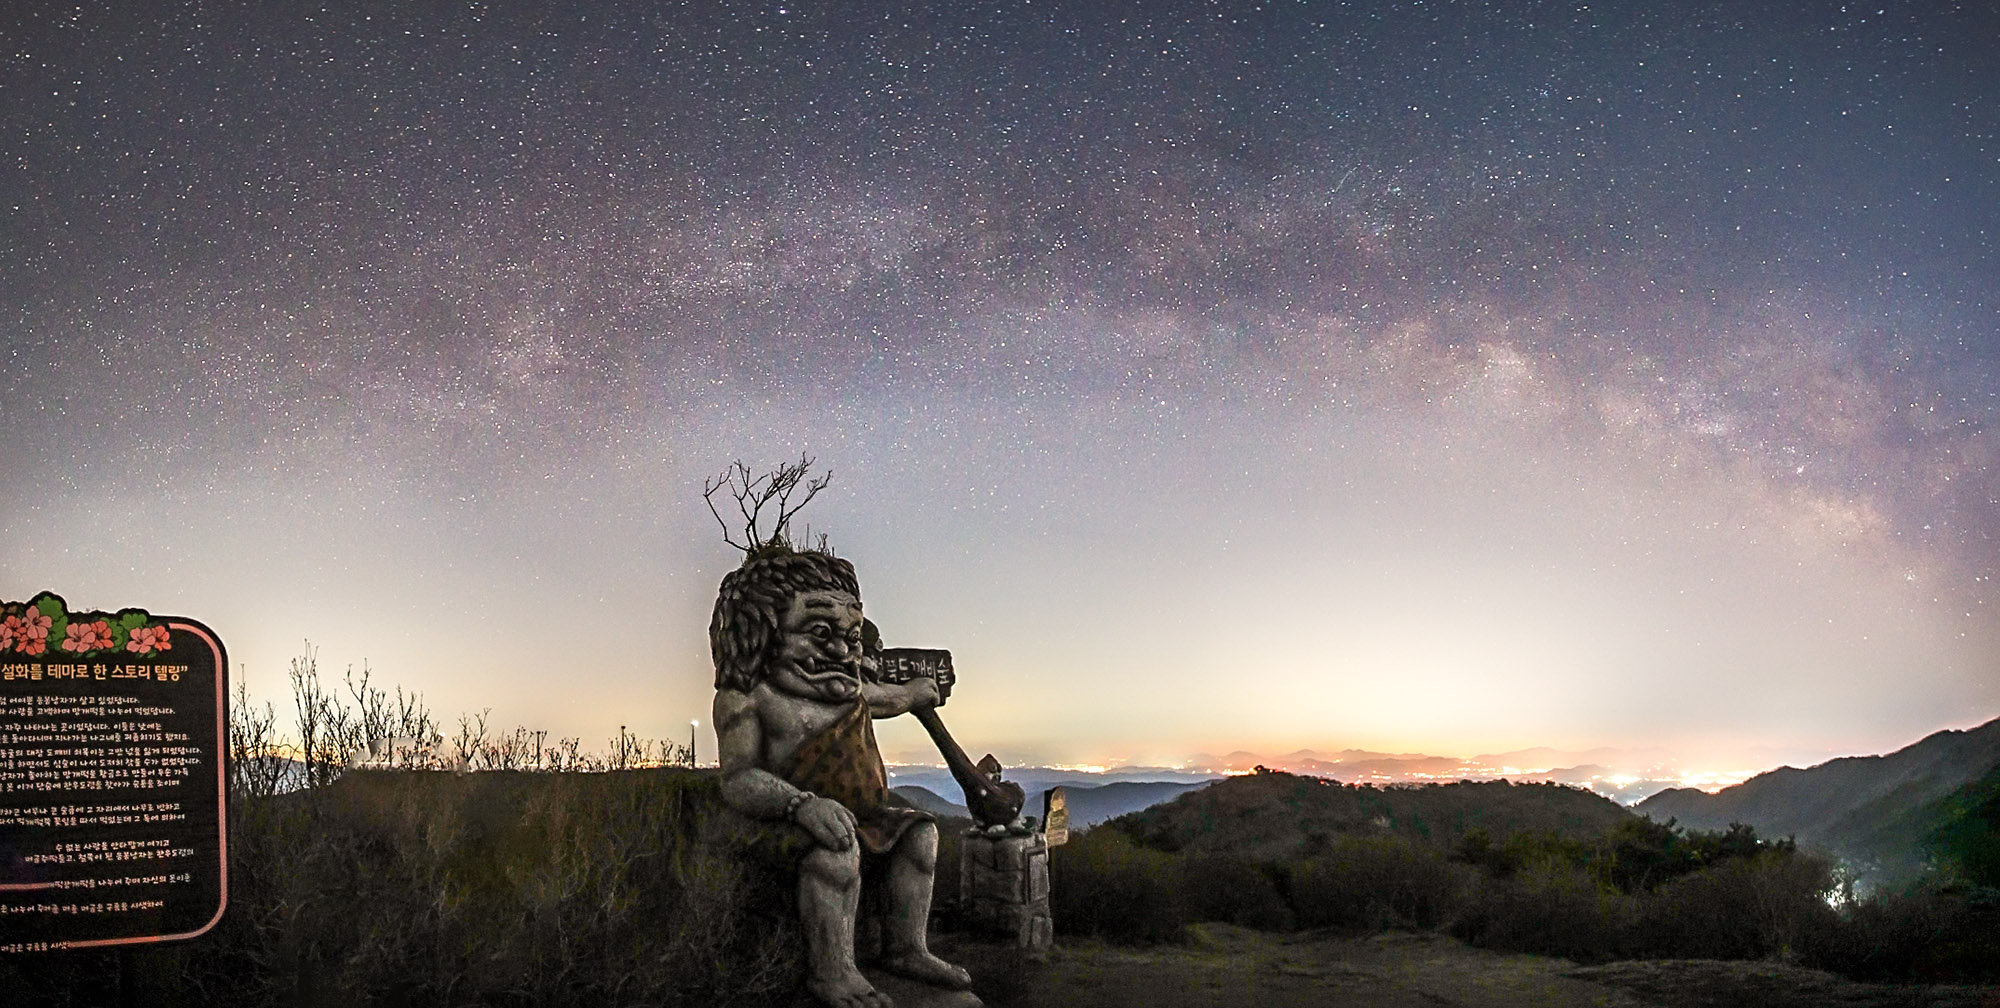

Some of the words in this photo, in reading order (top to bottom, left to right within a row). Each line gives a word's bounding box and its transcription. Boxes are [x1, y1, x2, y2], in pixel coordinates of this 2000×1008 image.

[2, 664, 42, 680] 설화를
[48, 664, 89, 679] 테마로
[93, 664, 107, 680] 한
[111, 665, 150, 679] 스토리
[155, 665, 188, 681] 텔링”
[10, 696, 33, 705] 어여쁜
[37, 696, 77, 705] 응봉낭자가
[80, 697, 95, 705] 살고
[98, 696, 139, 705] 있었답니다.
[9, 708, 33, 716] 사랑을
[37, 707, 70, 716] 고백하며
[72, 707, 105, 715] 망개떡을
[108, 707, 132, 715] 나누어
[135, 707, 175, 715] 먹었답니다.
[5, 723, 21, 731] 자주
[24, 723, 57, 732] 나타나는
[61, 723, 110, 732] 곳이었답니다.
[114, 722, 135, 731] 이들은
[138, 722, 161, 731] 낮에는
[12, 734, 52, 743] 돌아다니며
[55, 734, 87, 743] 지나가는
[90, 733, 121, 742] 나그네를
[125, 733, 162, 742] 괴롭히기도
[165, 733, 190, 741] 했지요.
[1, 749, 23, 758] 동굴의
[27, 749, 43, 757] 대장
[47, 748, 71, 757] 도깨비
[108, 748, 123, 757] 그만
[162, 747, 201, 755] 되었답니다.
[18, 760, 49, 768] 하면서도
[53, 759, 77, 768] 심술이
[80, 759, 96, 767] 나서
[100, 758, 123, 767] 도저히
[144, 758, 159, 766] 수가
[161, 758, 201, 766] 없었답니다.
[29, 771, 59, 780] 좋아하는
[99, 770, 129, 778] 황금으로
[132, 768, 155, 777] 만들어
[96, 805, 129, 813] 자리에서
[84, 842, 107, 850] 사랑을
